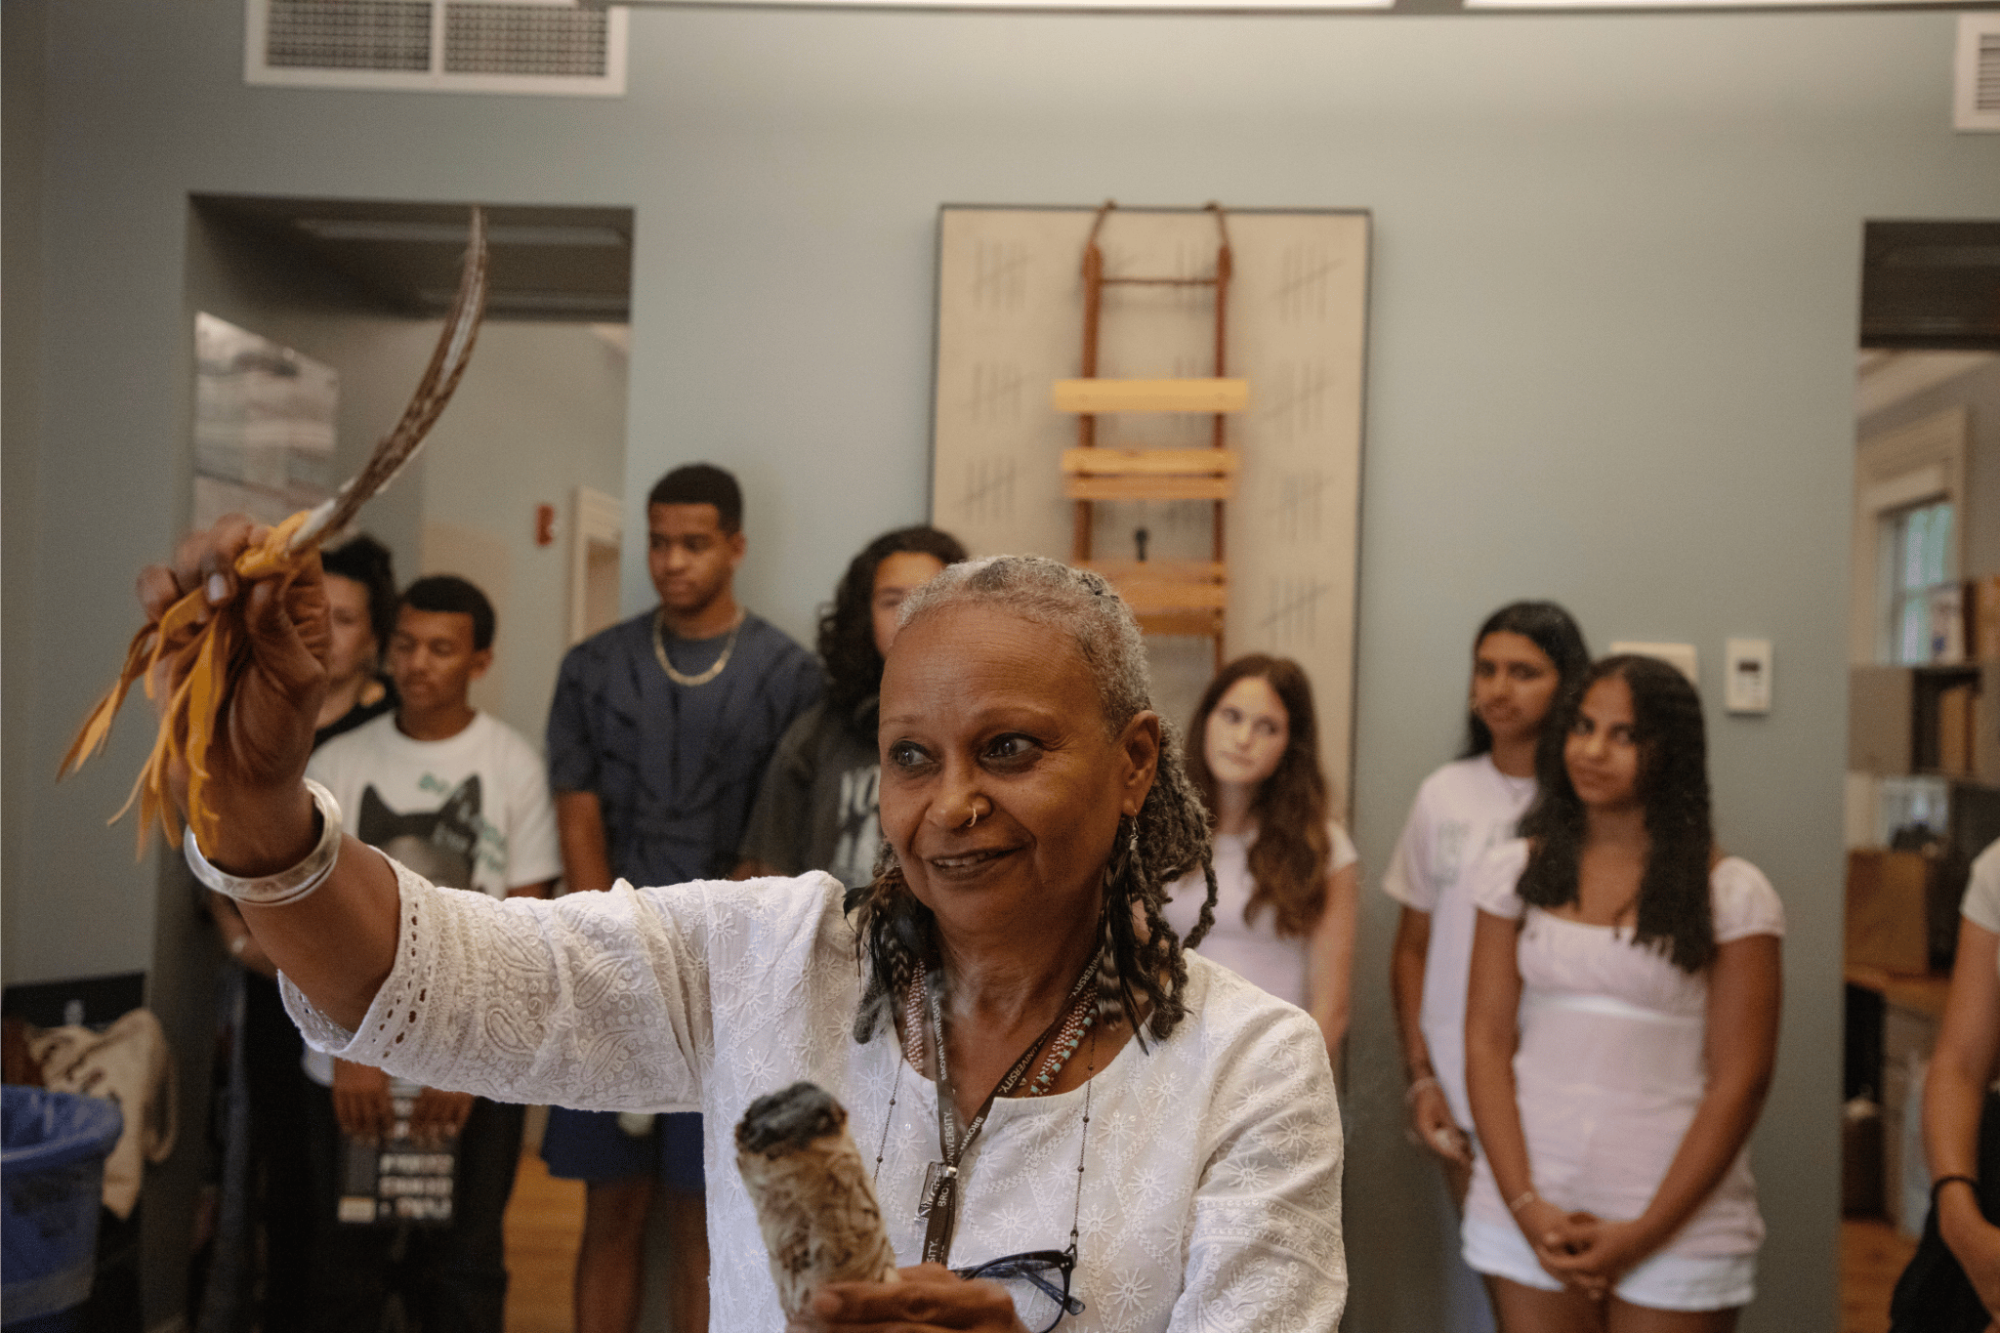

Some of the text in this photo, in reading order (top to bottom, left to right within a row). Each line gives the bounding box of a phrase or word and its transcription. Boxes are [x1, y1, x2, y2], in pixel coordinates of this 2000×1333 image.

[931, 996, 948, 1081] BROWN UNIVERSITY
[1001, 1046, 1038, 1094] UNIVERSITY
[943, 1111, 955, 1167] UNIVERSITY
